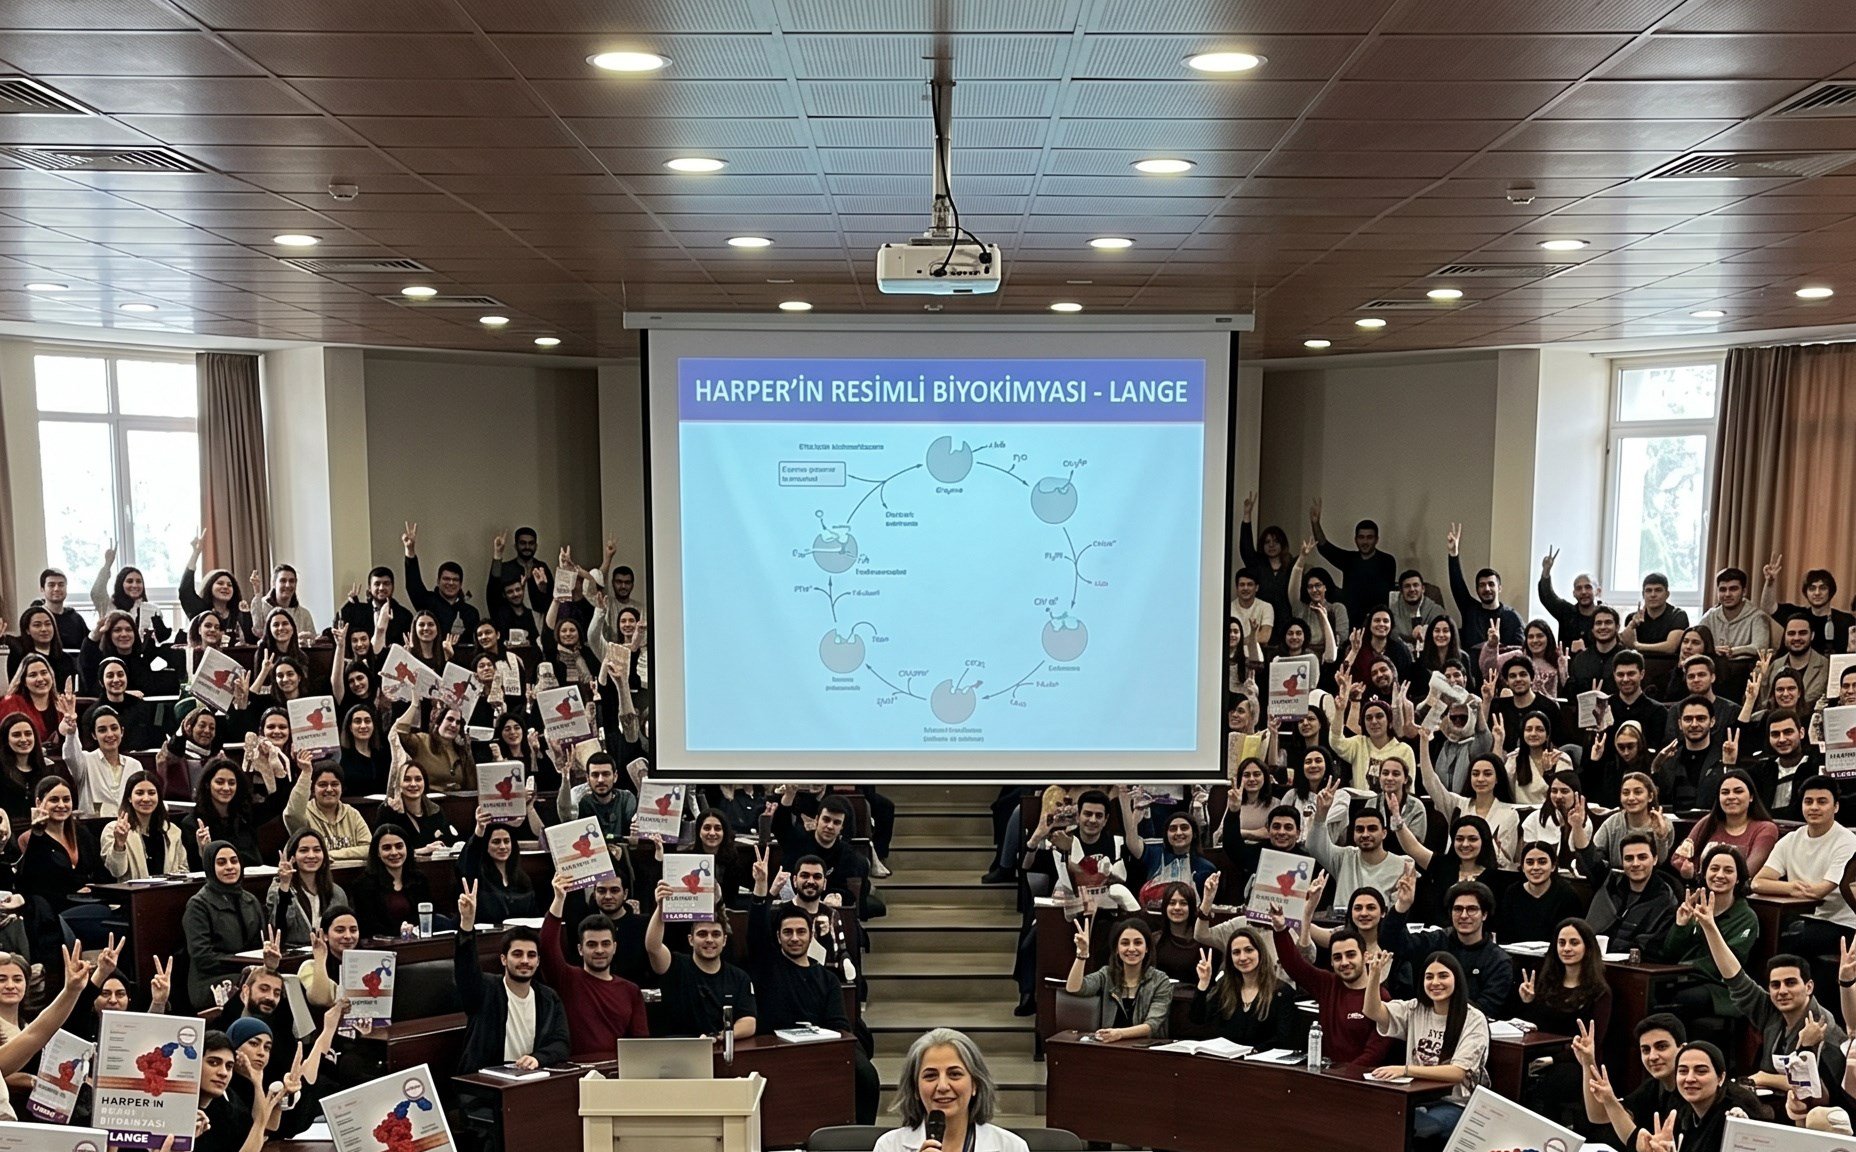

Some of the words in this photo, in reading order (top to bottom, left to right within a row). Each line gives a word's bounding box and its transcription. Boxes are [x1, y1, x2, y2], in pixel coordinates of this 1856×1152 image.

[695, 374, 823, 403] HARPER'İN
[832, 374, 925, 403] RESİMLİ
[933, 374, 1086, 403] BİYOKİMYASI
[1109, 380, 1188, 403] LANGE
[109, 1132, 149, 1143] LANGE
